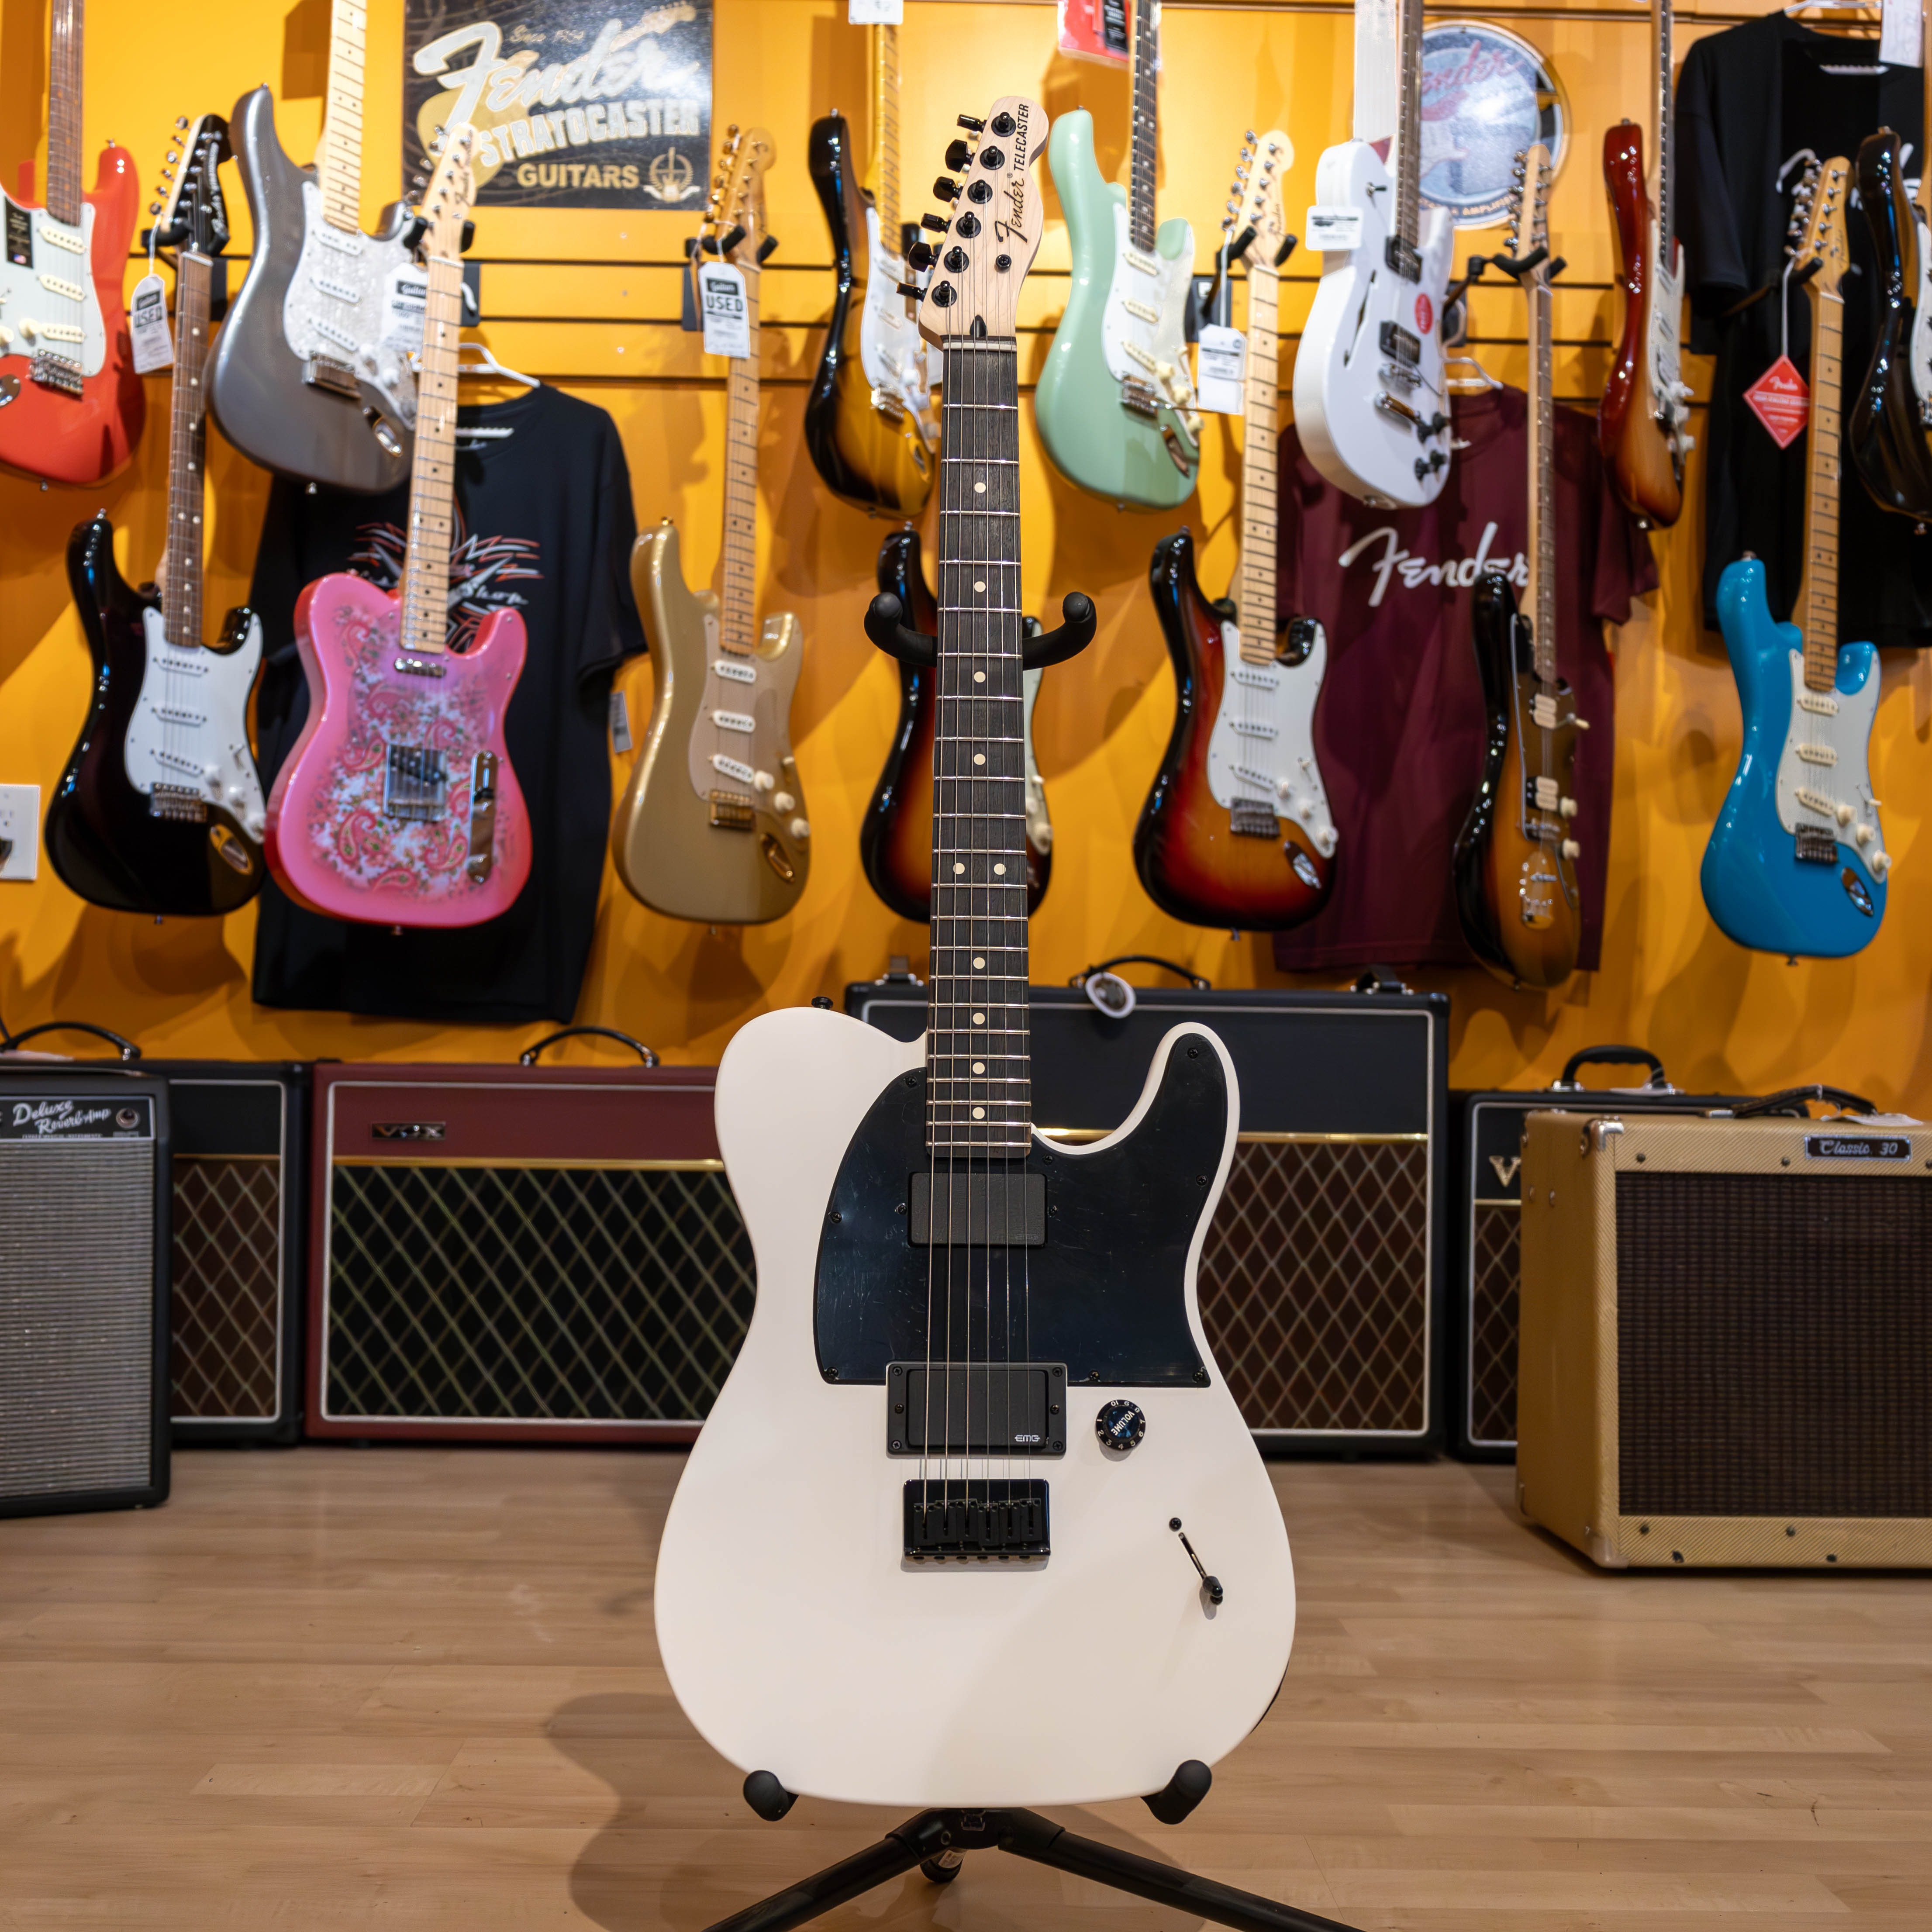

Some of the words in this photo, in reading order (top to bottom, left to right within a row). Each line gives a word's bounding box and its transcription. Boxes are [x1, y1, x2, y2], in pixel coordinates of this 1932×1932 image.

[414, 18, 699, 153] Fender
[480, 99, 699, 167] STRATOCASTER
[517, 163, 639, 189] GUITARS
[994, 178, 1028, 243] Fender
[1014, 104, 1029, 171] TELECASTER
[706, 295, 743, 312] USED
[1338, 521, 1529, 607] Fender
[13, 1100, 74, 1127] Deluxe
[1818, 1139, 1870, 1155] Classic
[1879, 1142, 1898, 1156] 30
[1111, 1411, 1135, 1435] VOLUME
